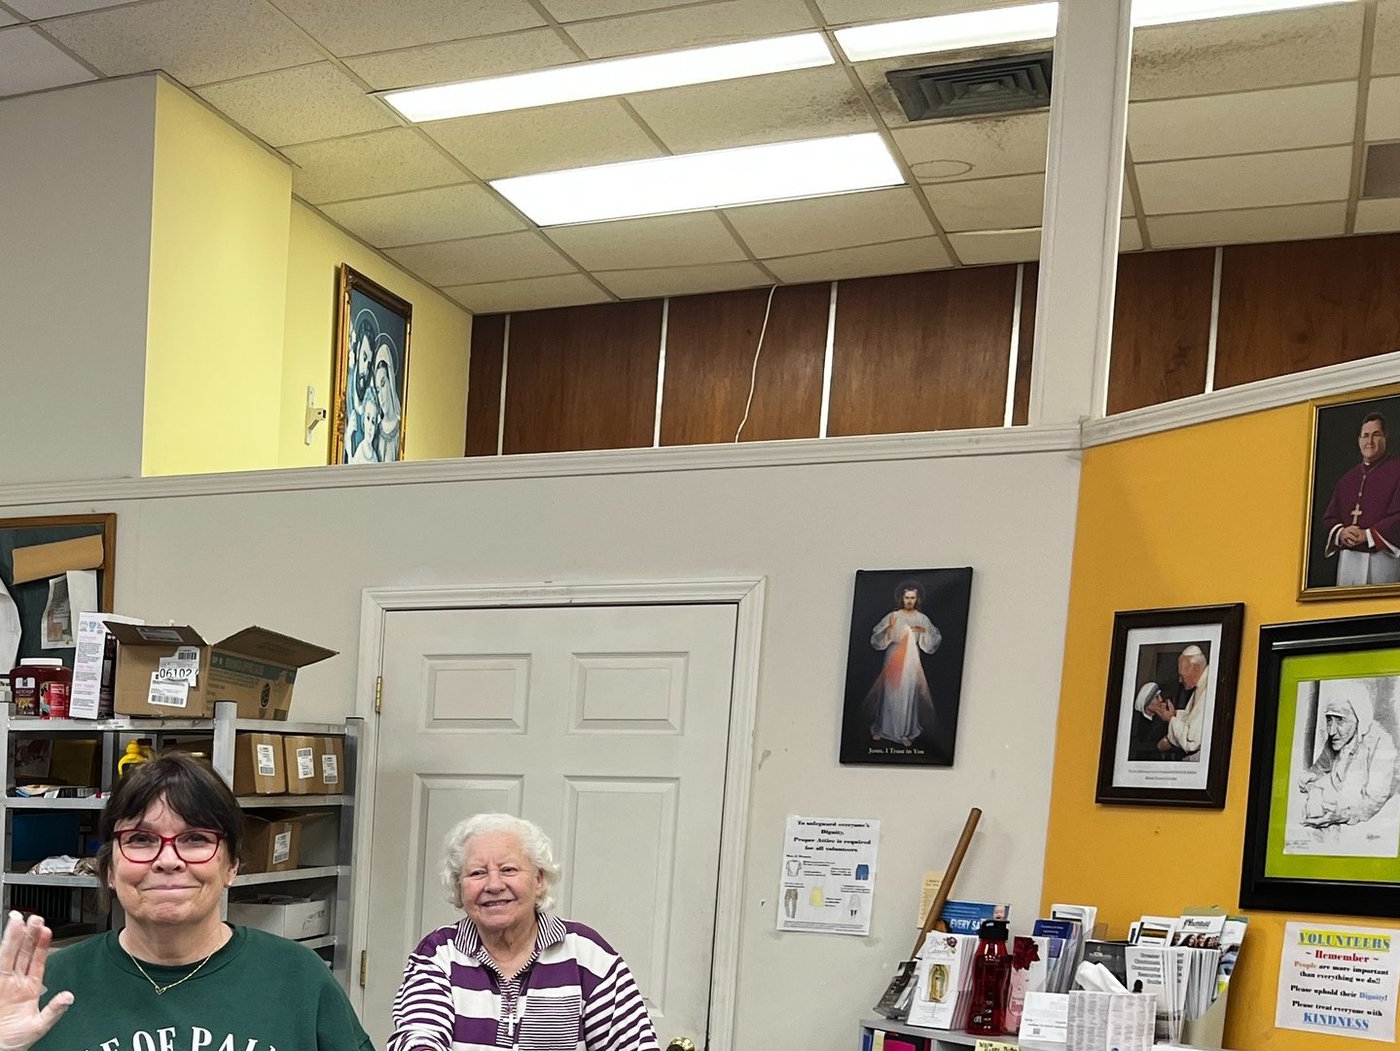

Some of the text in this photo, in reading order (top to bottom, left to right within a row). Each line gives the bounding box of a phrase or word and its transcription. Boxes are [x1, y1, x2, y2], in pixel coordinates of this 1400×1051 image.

[949, 918, 971, 930] EVERY
[1299, 932, 1391, 949] VOLUNTEERS
[1315, 950, 1369, 963] Remember
[1294, 960, 1317, 970] People
[1352, 966, 1389, 975] important
[1317, 973, 1354, 983] everything
[1290, 984, 1388, 1003] Please uphold their Dignity!
[1292, 1000, 1313, 1009] Please
[1316, 1003, 1332, 1011] treat
[1333, 1006, 1364, 1014] everyone
[1303, 1012, 1369, 1029] KINDNESS
